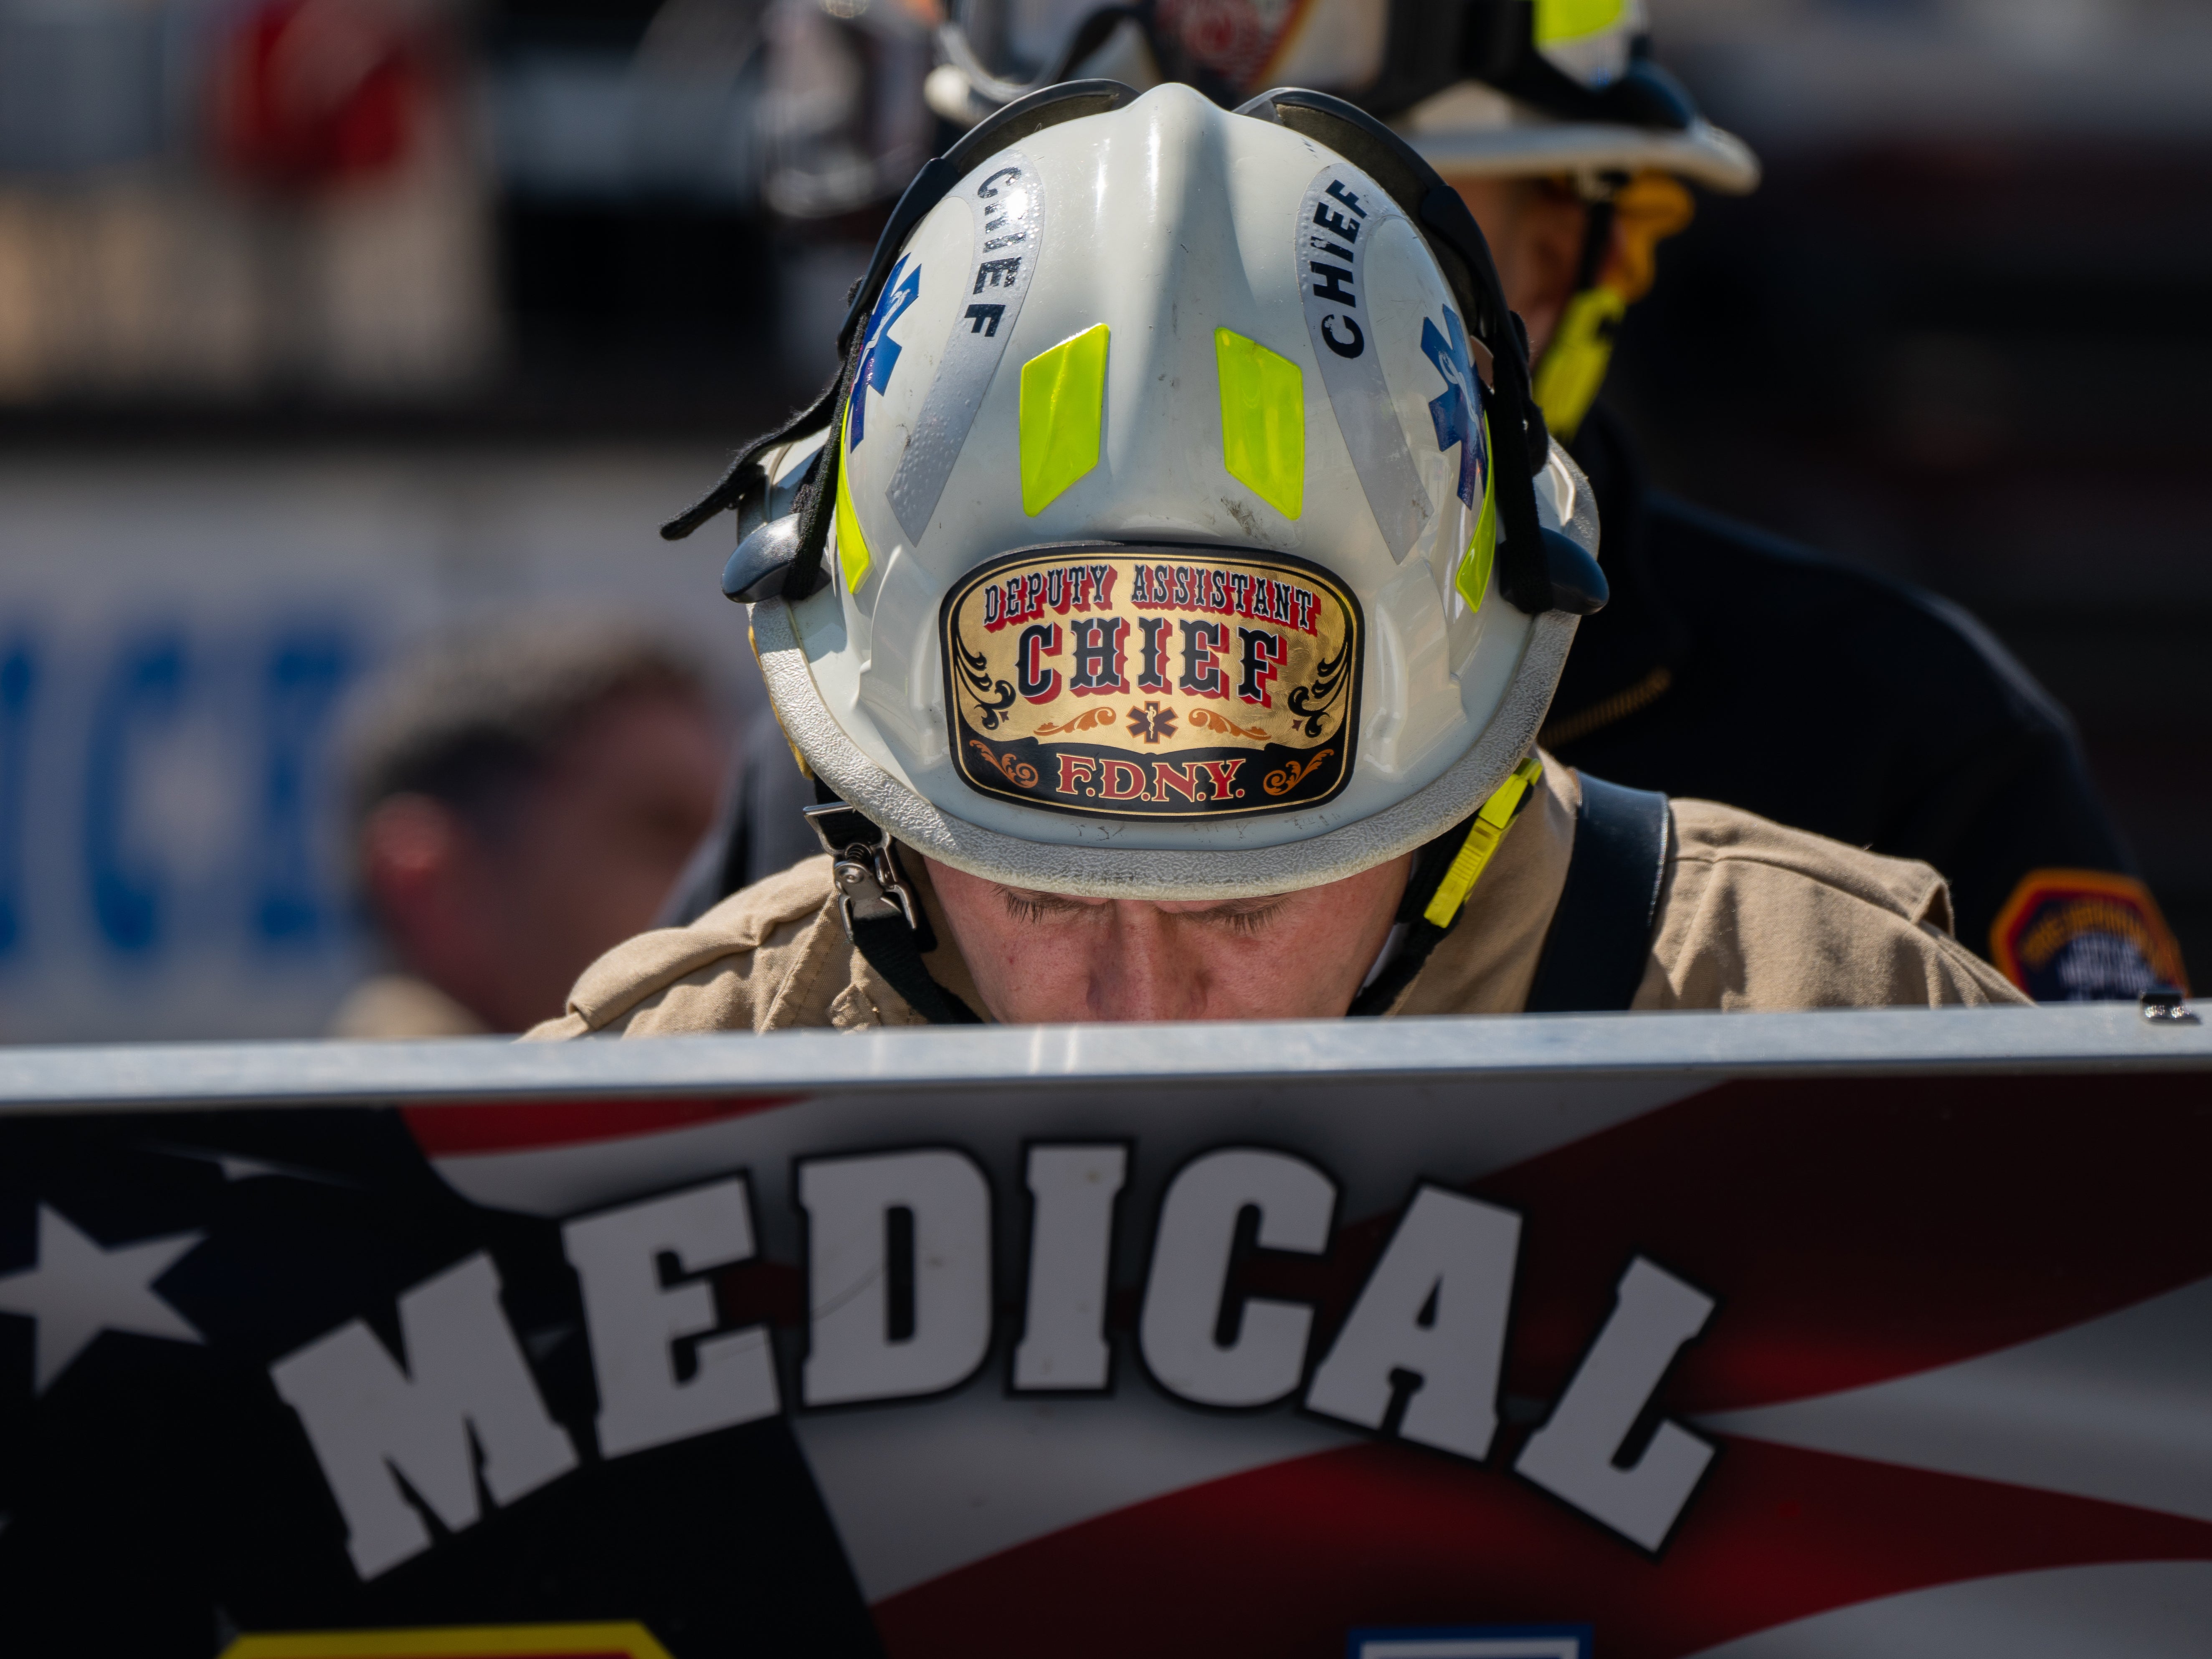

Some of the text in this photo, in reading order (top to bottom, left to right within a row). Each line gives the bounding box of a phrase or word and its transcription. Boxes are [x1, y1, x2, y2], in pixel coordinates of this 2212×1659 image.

[1310, 179, 1368, 359] CHIEF
[983, 564, 1322, 637] DEPUTY ASSISTANT
[1014, 615, 1288, 709] CHIEF
[1056, 753, 1247, 803] F.D.N.Y.
[268, 1144, 1718, 1582] MEDICAL
